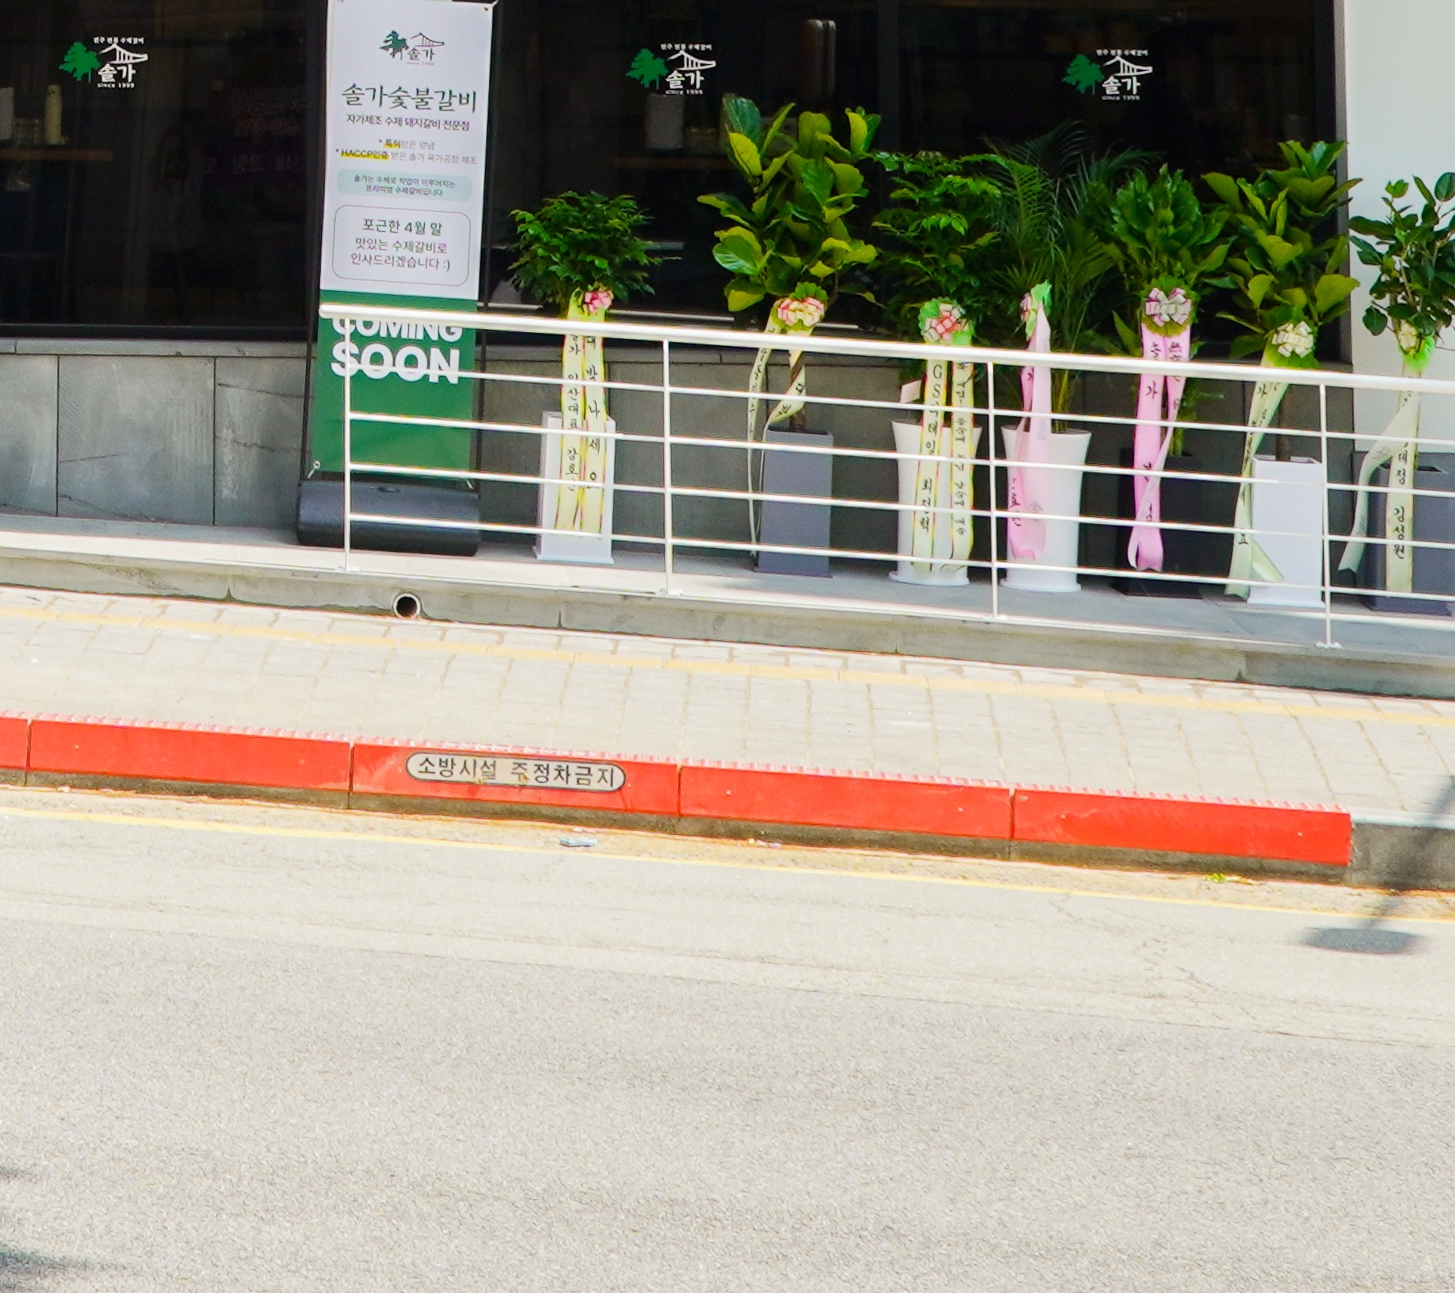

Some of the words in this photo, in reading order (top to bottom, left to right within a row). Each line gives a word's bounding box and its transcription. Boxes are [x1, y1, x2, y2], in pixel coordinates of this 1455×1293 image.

[407, 47, 435, 62] 솔가
[98, 63, 136, 82] 솔가
[665, 70, 705, 89] 솔가
[1102, 76, 1141, 95] 솔가
[342, 82, 477, 113] 솔가숯불갈비
[346, 114, 383, 125] 자가제조
[385, 117, 403, 127] 수제
[405, 118, 441, 130] 돼지갈비
[442, 120, 470, 132] 전문점
[362, 218, 400, 234] 포근한
[404, 220, 426, 235] 4월
[430, 222, 443, 236] 말
[355, 237, 388, 252] 맛있는
[392, 240, 448, 254] 수제갈비로
[350, 253, 440, 271] 인사드리겠습니다
[331, 317, 463, 344] COMING
[330, 342, 460, 385] SOON
[418, 757, 496, 781] 소방시설
[510, 761, 615, 789] 주정차금지
